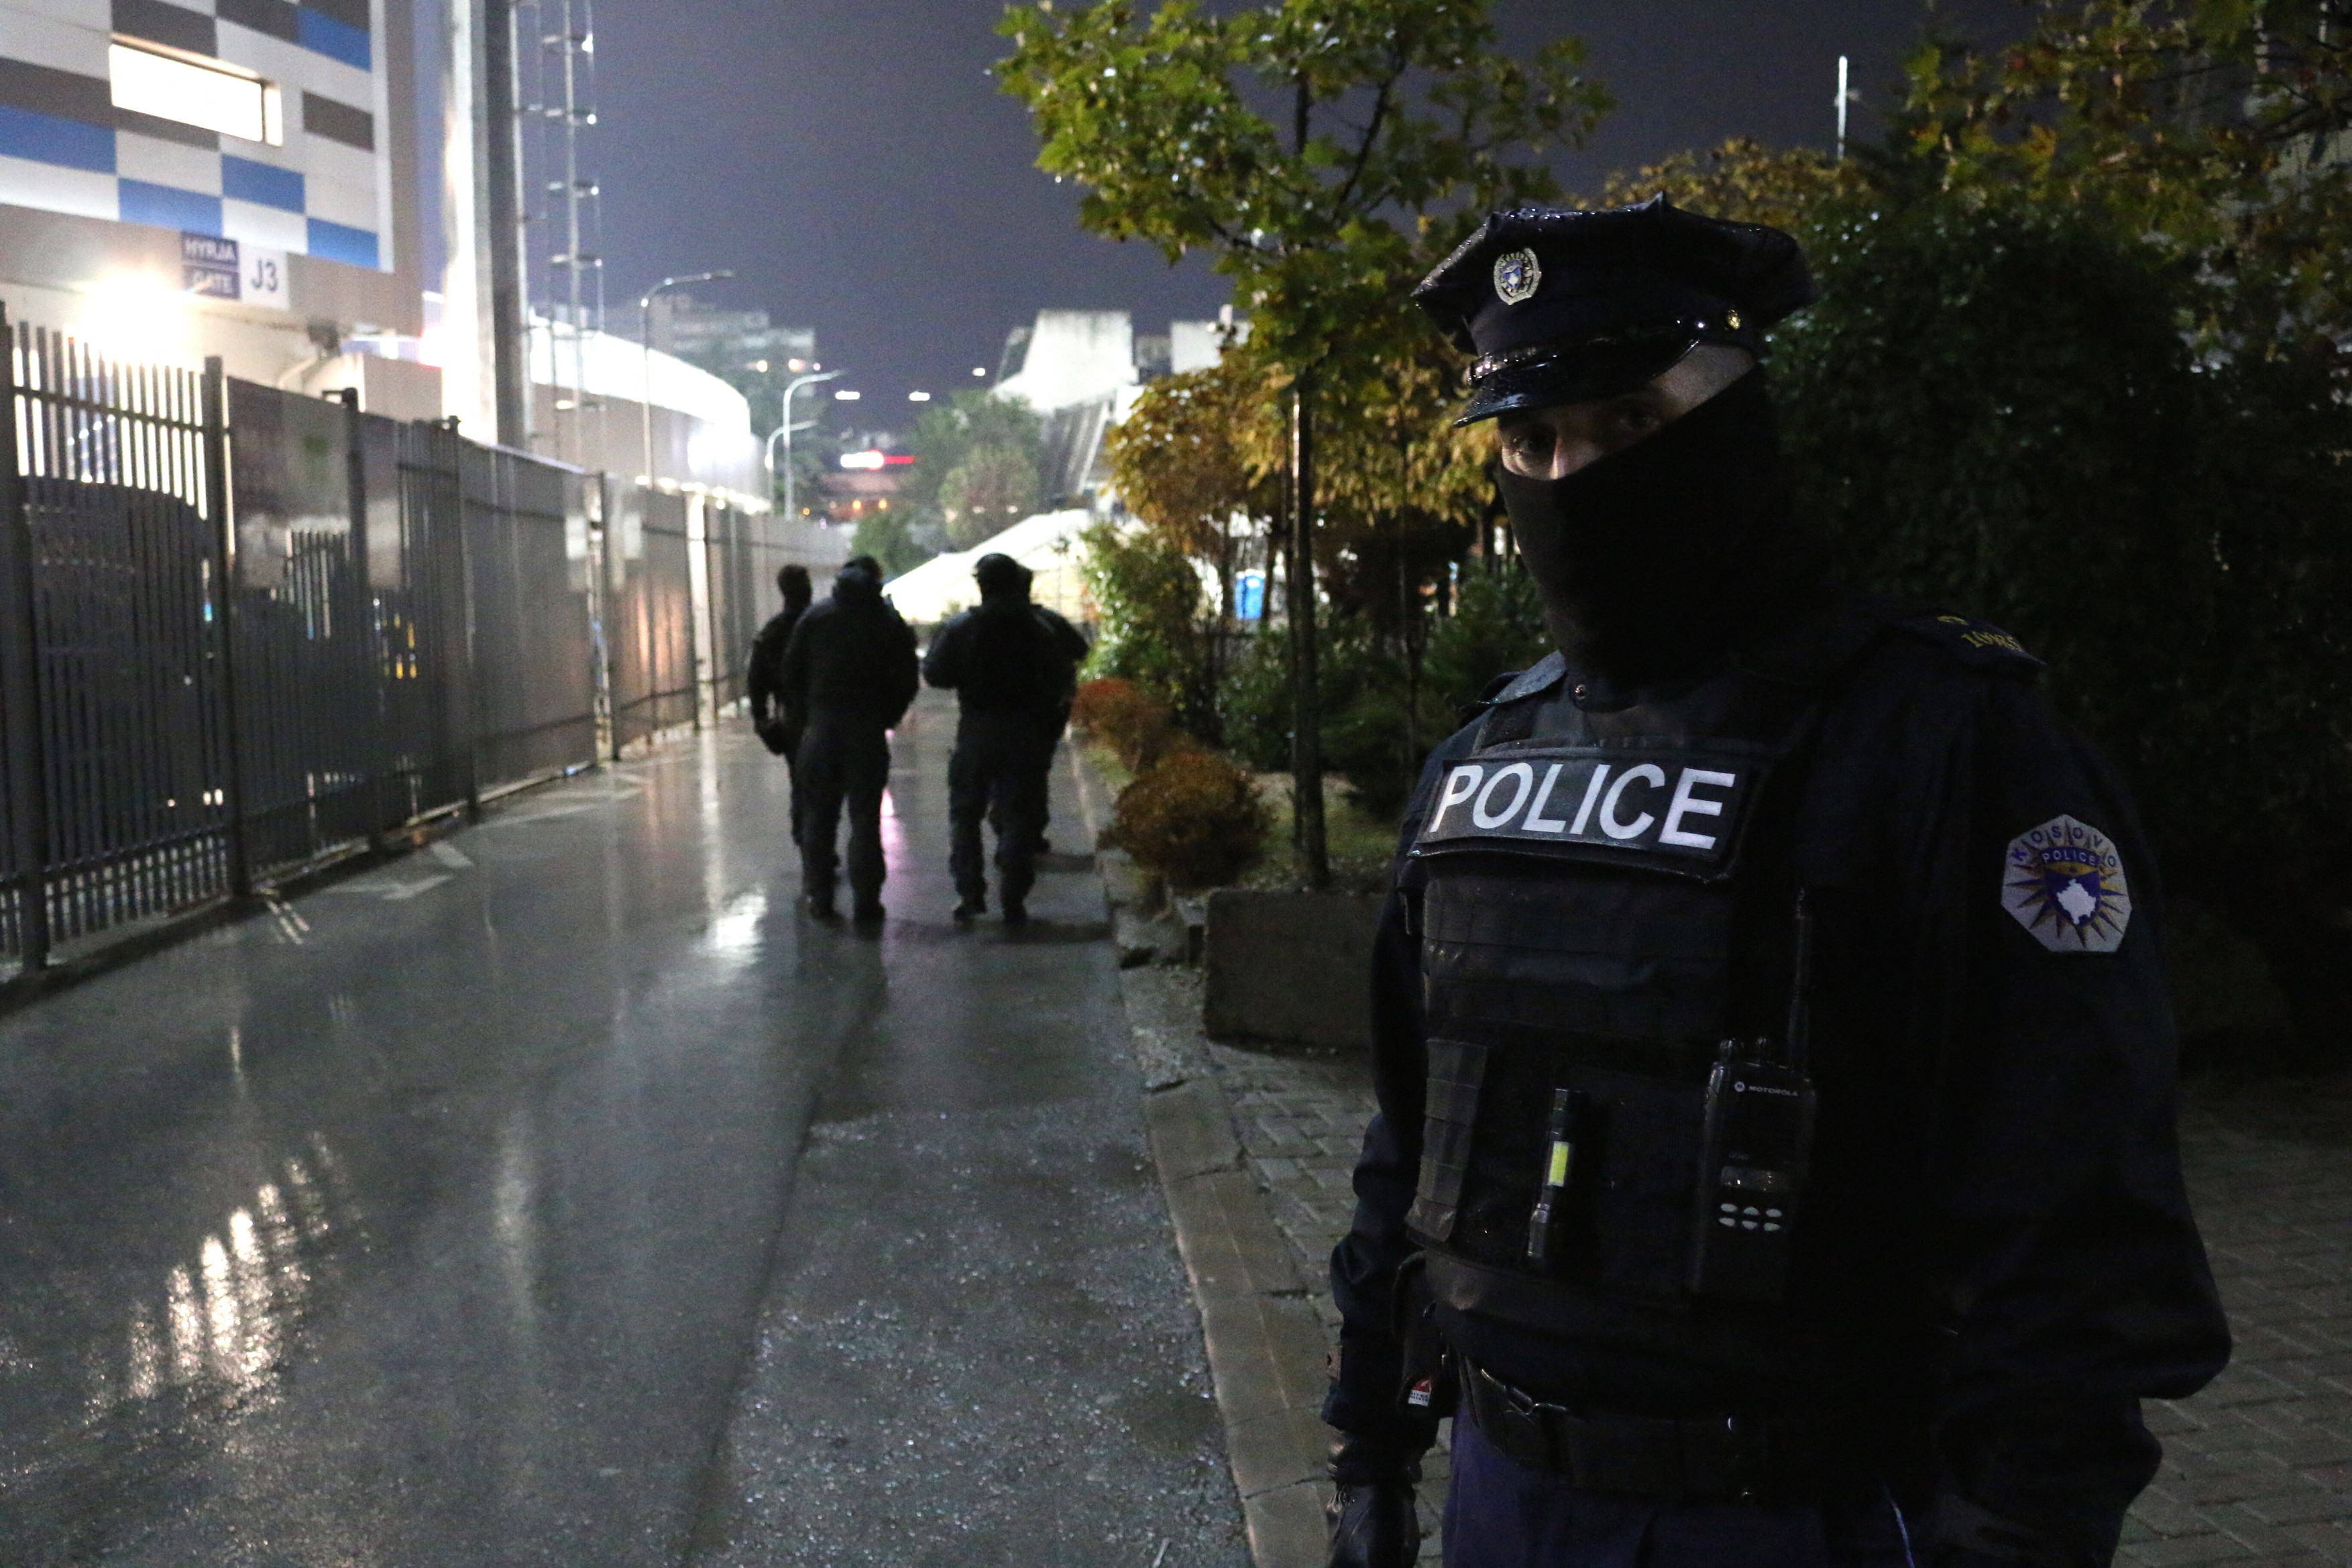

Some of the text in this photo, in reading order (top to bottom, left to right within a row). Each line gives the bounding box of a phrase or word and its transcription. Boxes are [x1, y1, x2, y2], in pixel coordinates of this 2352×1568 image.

[251, 258, 278, 292] J3
[1429, 763, 1736, 849] POLICE
[2011, 826, 2116, 866] KOSOVO
[2042, 849, 2096, 866] POLICE
[1748, 1086, 1798, 1096] MOTOROLA
